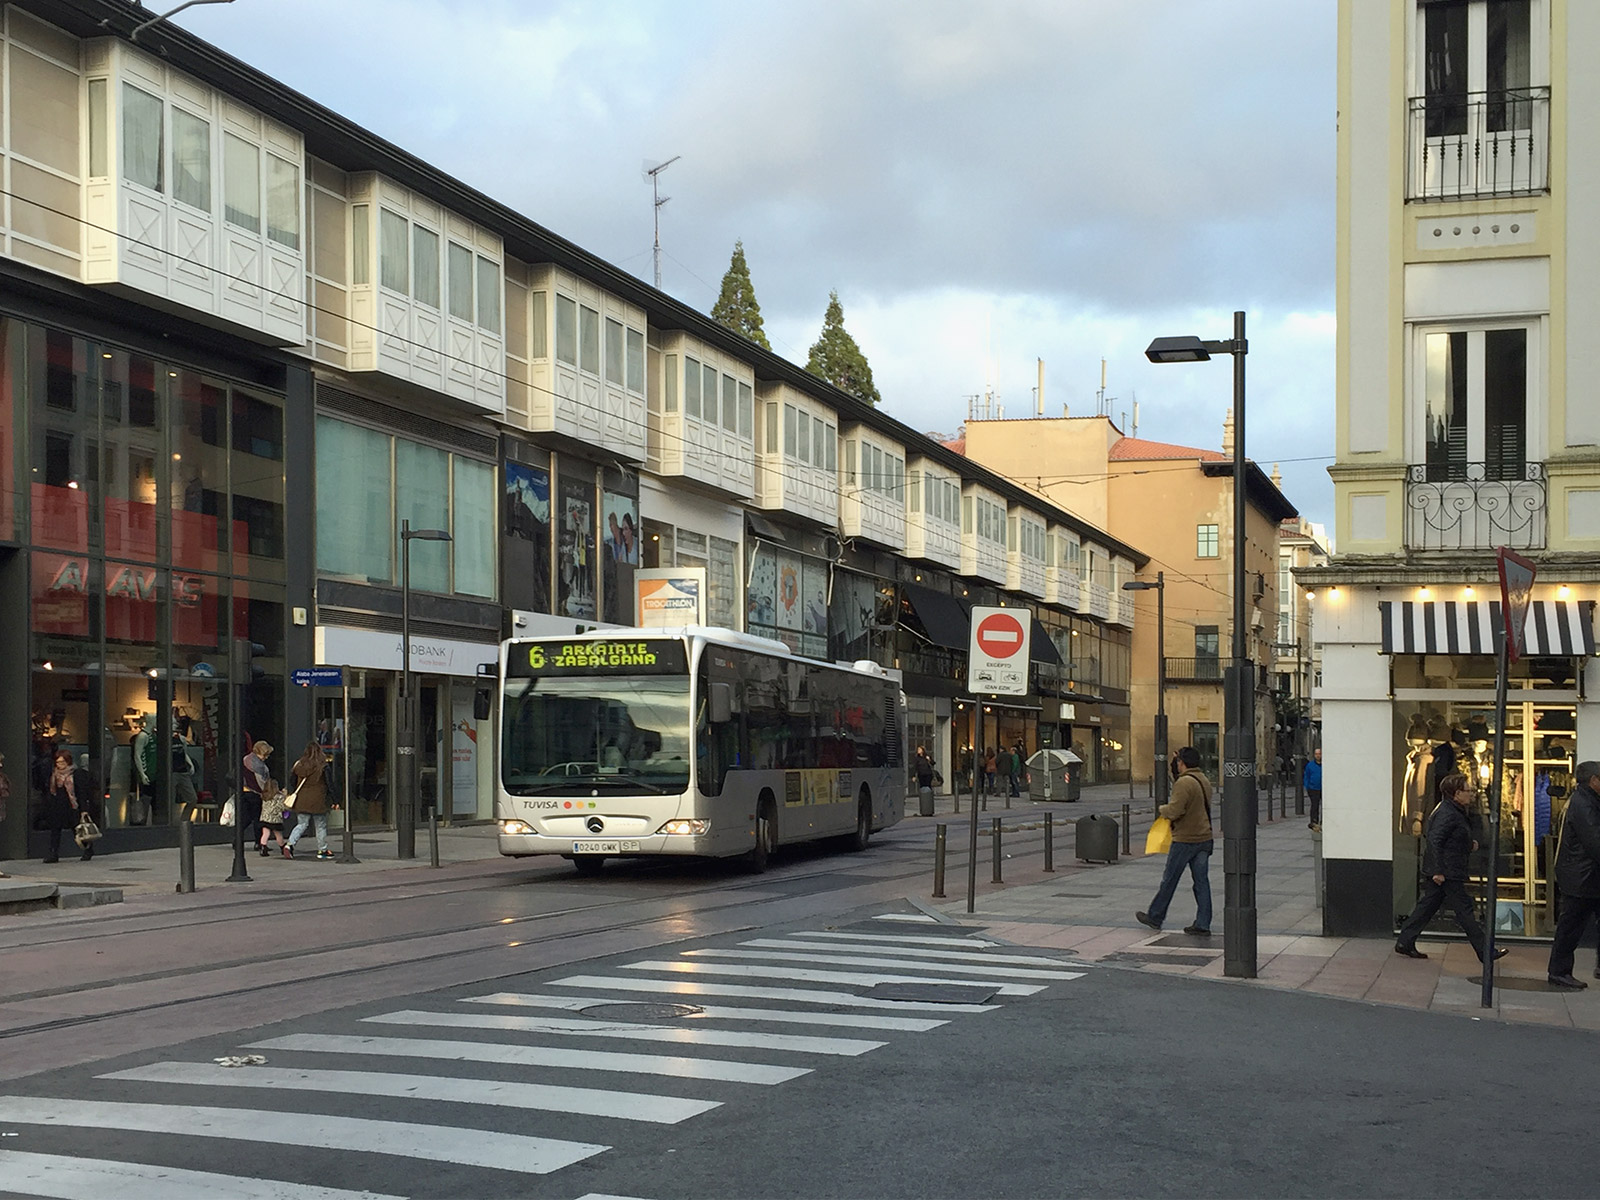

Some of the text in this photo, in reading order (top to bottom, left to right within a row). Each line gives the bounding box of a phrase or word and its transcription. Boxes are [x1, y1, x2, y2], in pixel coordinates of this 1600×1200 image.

[395, 642, 446, 657] ADBANK
[562, 643, 648, 656] ARKAIATE
[528, 645, 545, 669] 6
[554, 653, 657, 668] ZABALGANA
[523, 801, 559, 809] TUVISA
[579, 843, 617, 852] 0240 GMK
[622, 841, 638, 850] SP
